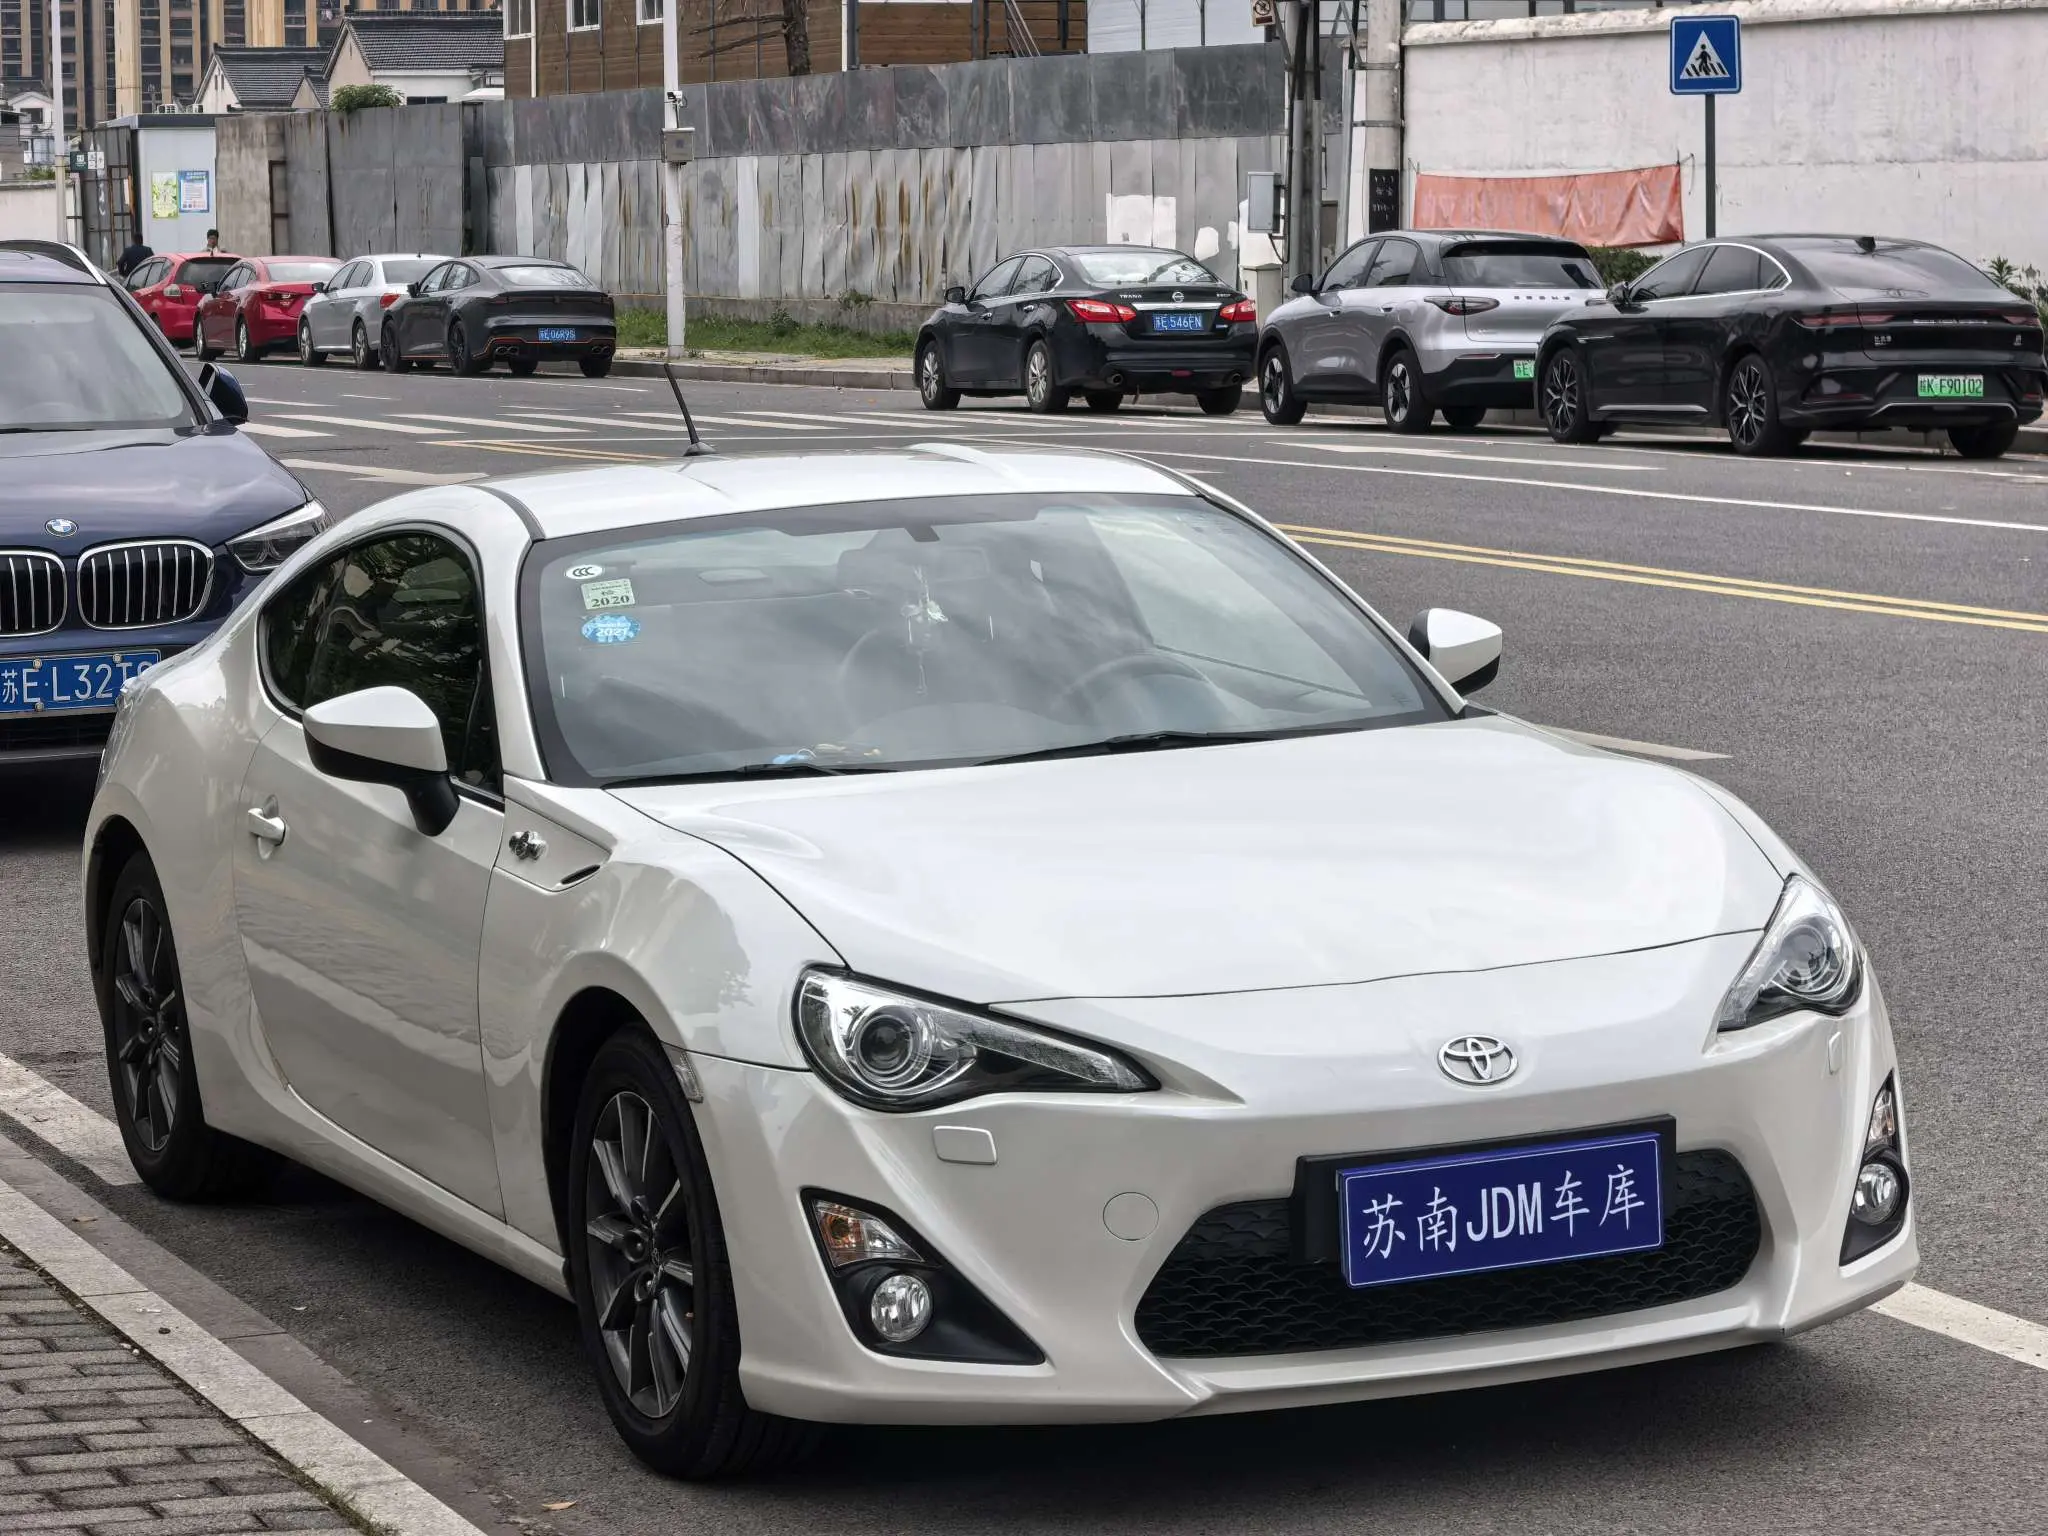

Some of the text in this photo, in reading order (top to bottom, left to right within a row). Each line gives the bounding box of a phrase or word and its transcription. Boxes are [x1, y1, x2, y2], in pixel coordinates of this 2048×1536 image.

[591, 595, 630, 608] 2020
[1362, 1164, 1645, 1259] 苏南JDM车库
